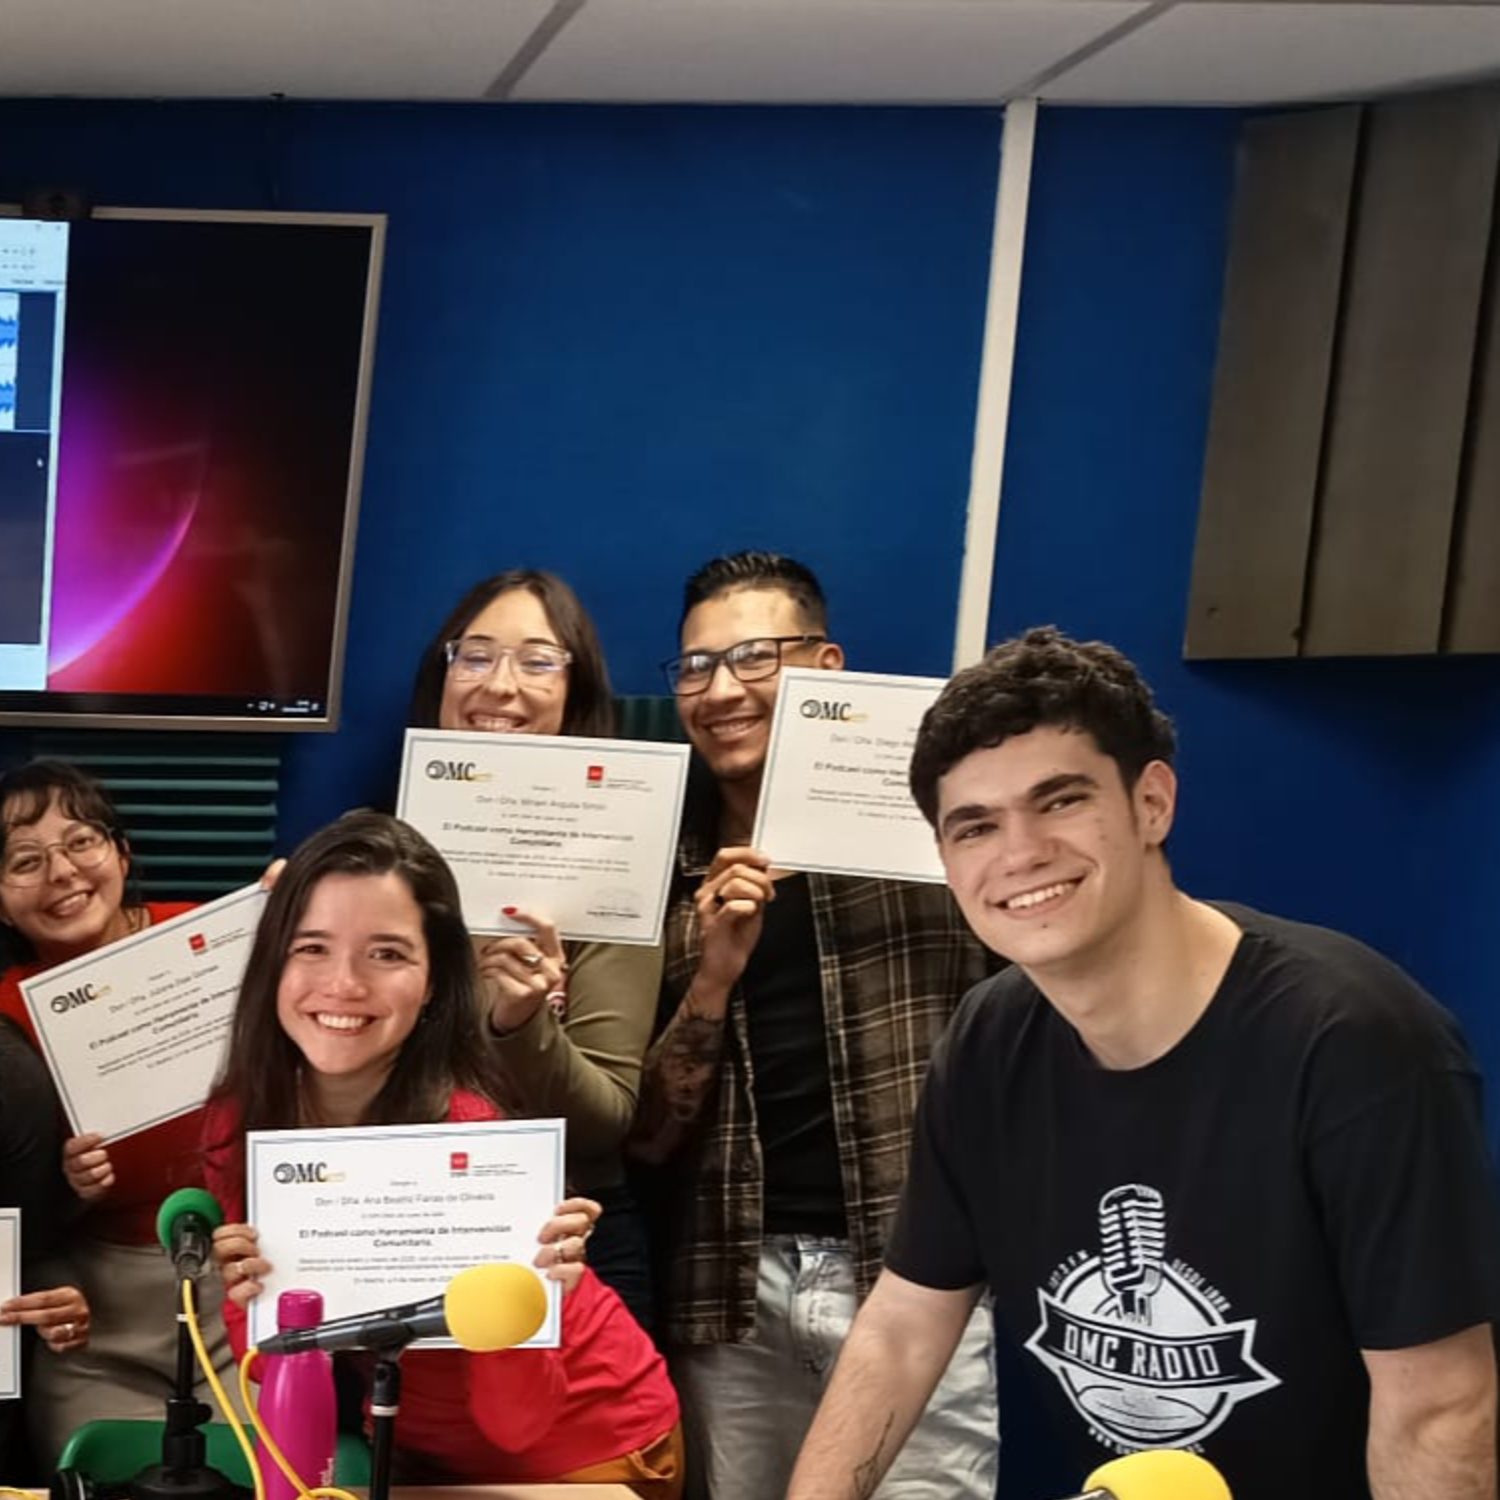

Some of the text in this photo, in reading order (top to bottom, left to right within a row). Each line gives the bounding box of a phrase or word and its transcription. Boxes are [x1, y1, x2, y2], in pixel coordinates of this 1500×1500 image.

[799, 698, 851, 721] OMC
[426, 760, 475, 780] OMC
[49, 984, 96, 1013] OMC
[273, 1161, 327, 1183] OMC
[1064, 1323, 1221, 1379] OMC RADIO
